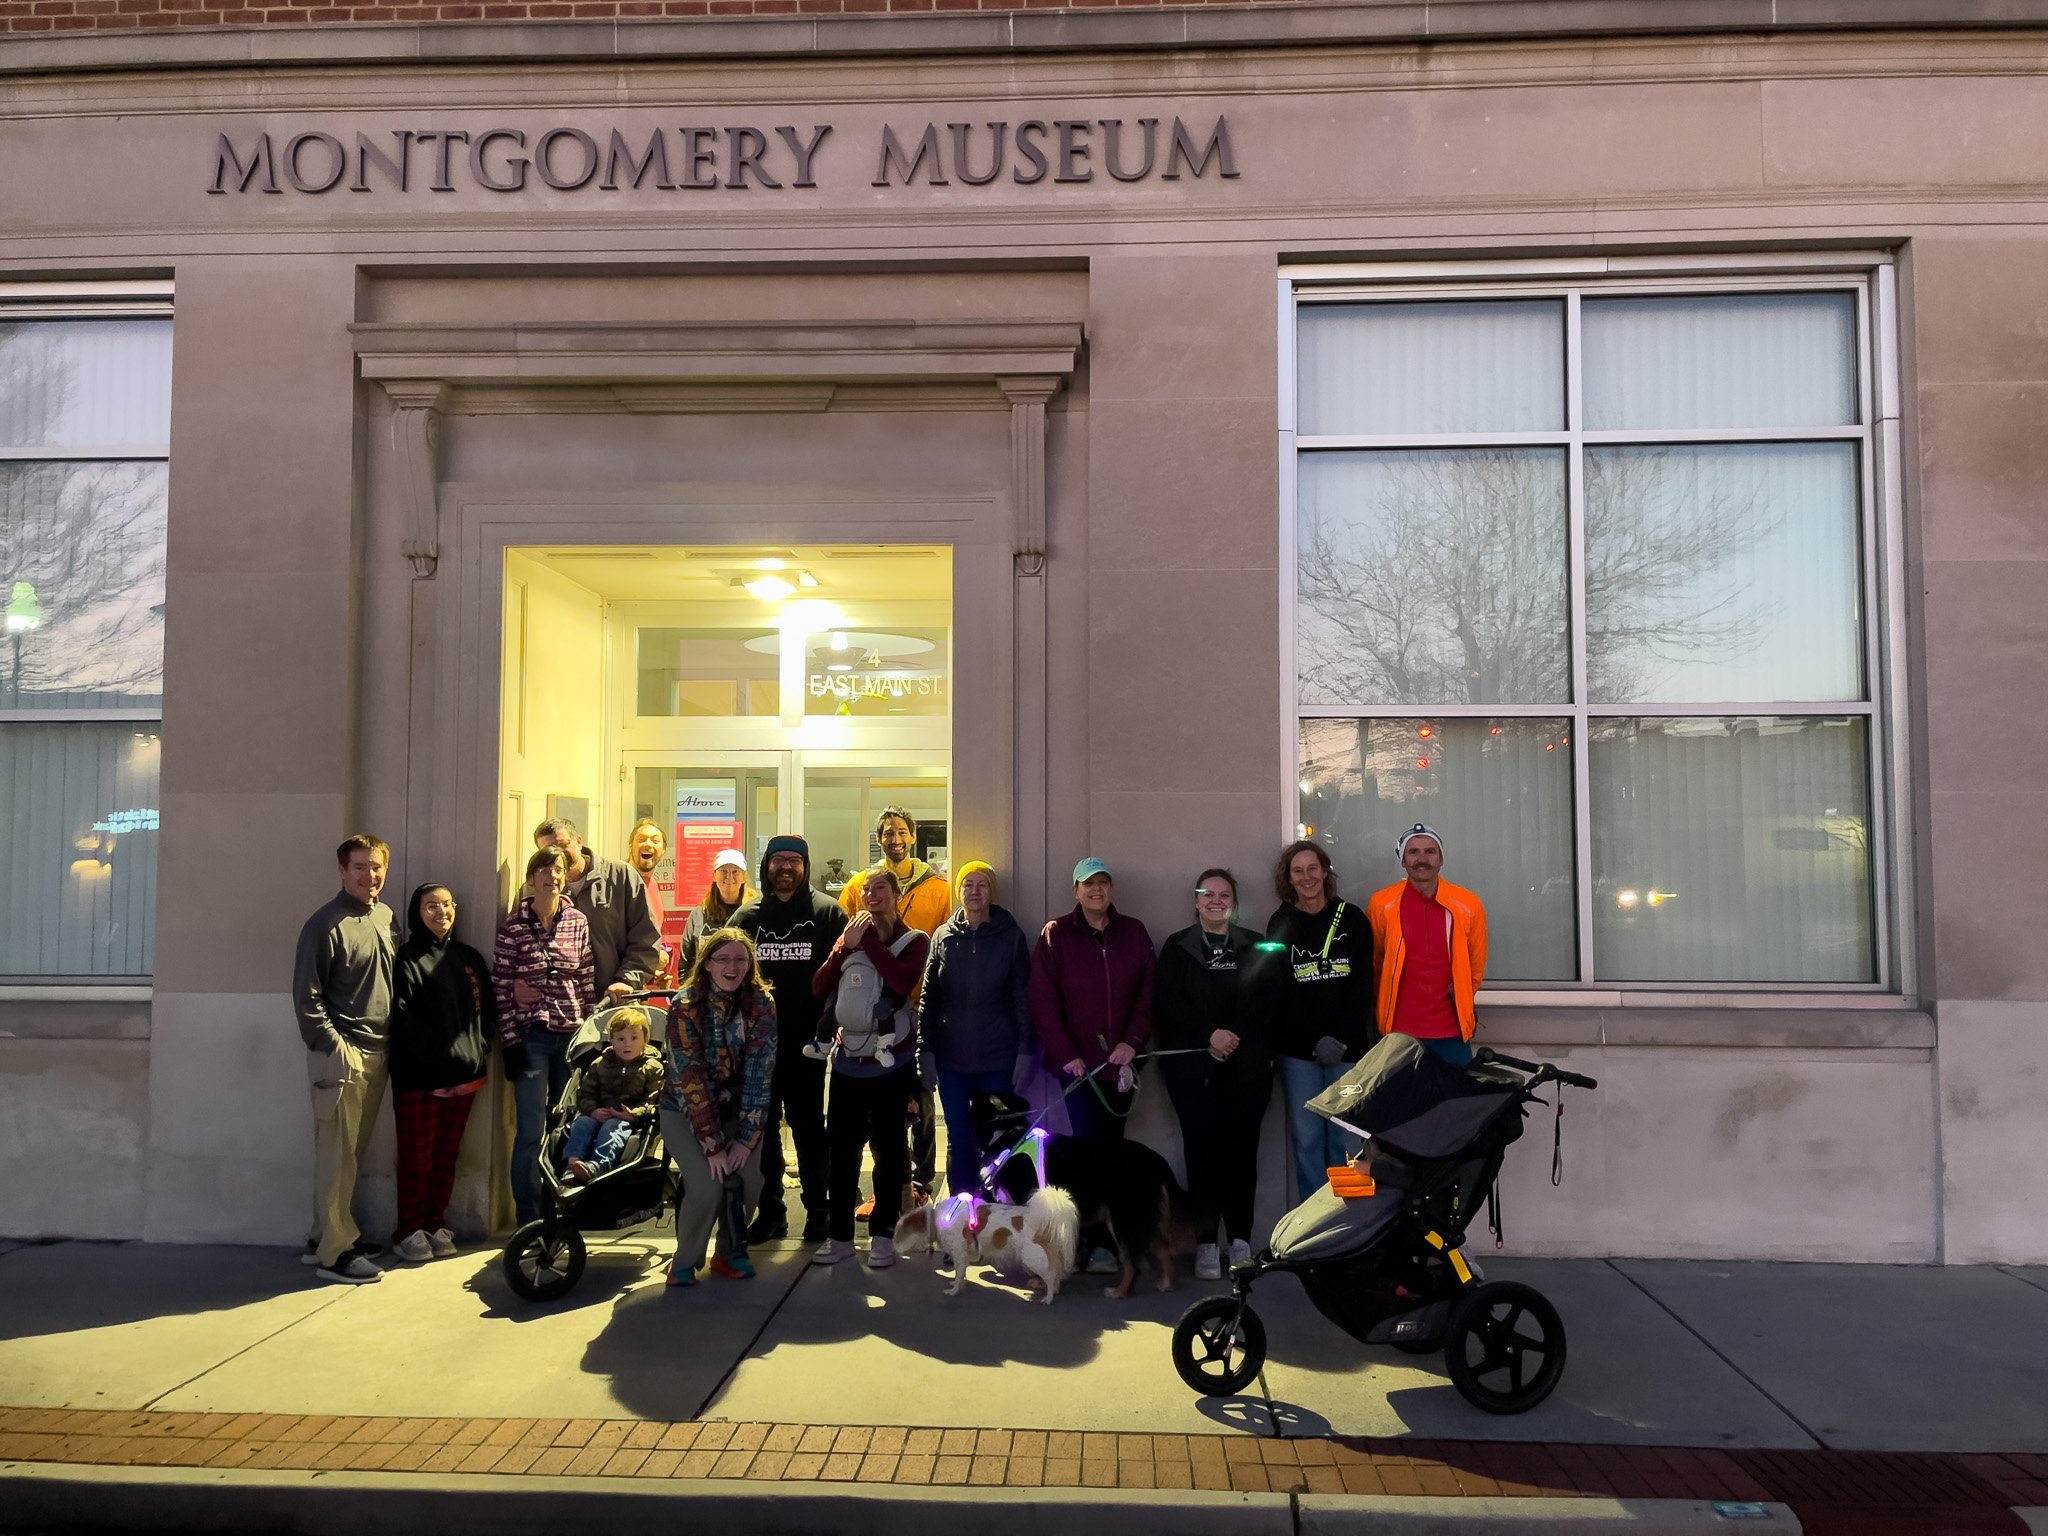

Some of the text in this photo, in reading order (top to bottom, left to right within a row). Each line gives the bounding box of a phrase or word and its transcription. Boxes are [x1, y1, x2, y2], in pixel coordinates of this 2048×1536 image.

[205, 114, 1241, 194] MONTGOMERY MUSEUM
[868, 648, 881, 667] 4
[810, 674, 943, 695] EAST MAIN ST.
[677, 795, 726, 807] Above
[782, 948, 812, 957] CLUB
